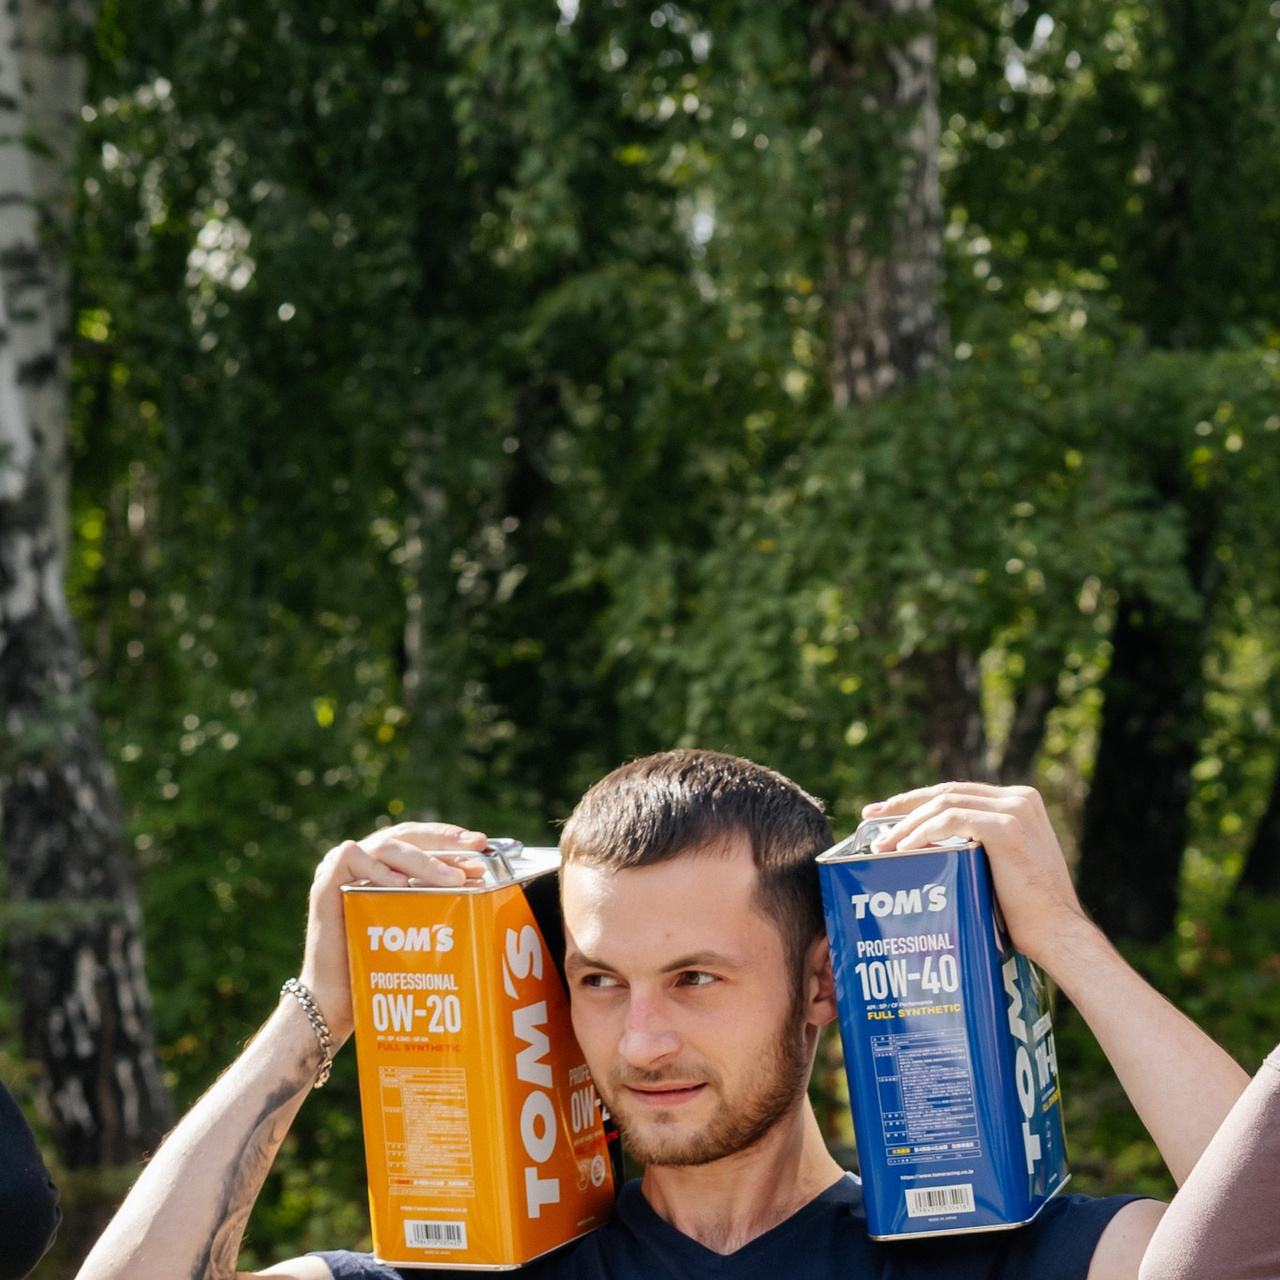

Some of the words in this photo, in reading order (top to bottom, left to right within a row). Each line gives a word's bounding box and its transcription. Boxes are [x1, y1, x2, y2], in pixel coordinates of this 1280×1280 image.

[851, 884, 948, 919] TOM'S
[367, 924, 454, 953] TOM'S
[856, 932, 955, 959] PROFESSIONAL
[370, 972, 459, 991] PROFESSIONAL
[854, 954, 960, 1001] 10W-40
[372, 994, 462, 1033] 0W-20
[867, 1010, 896, 1020] FULL
[898, 1004, 961, 1018] SYNTHETIC
[377, 1043, 401, 1051] FULL
[404, 1044, 462, 1053] SYNTHETIC
[502, 923, 561, 1219] TOM'S
